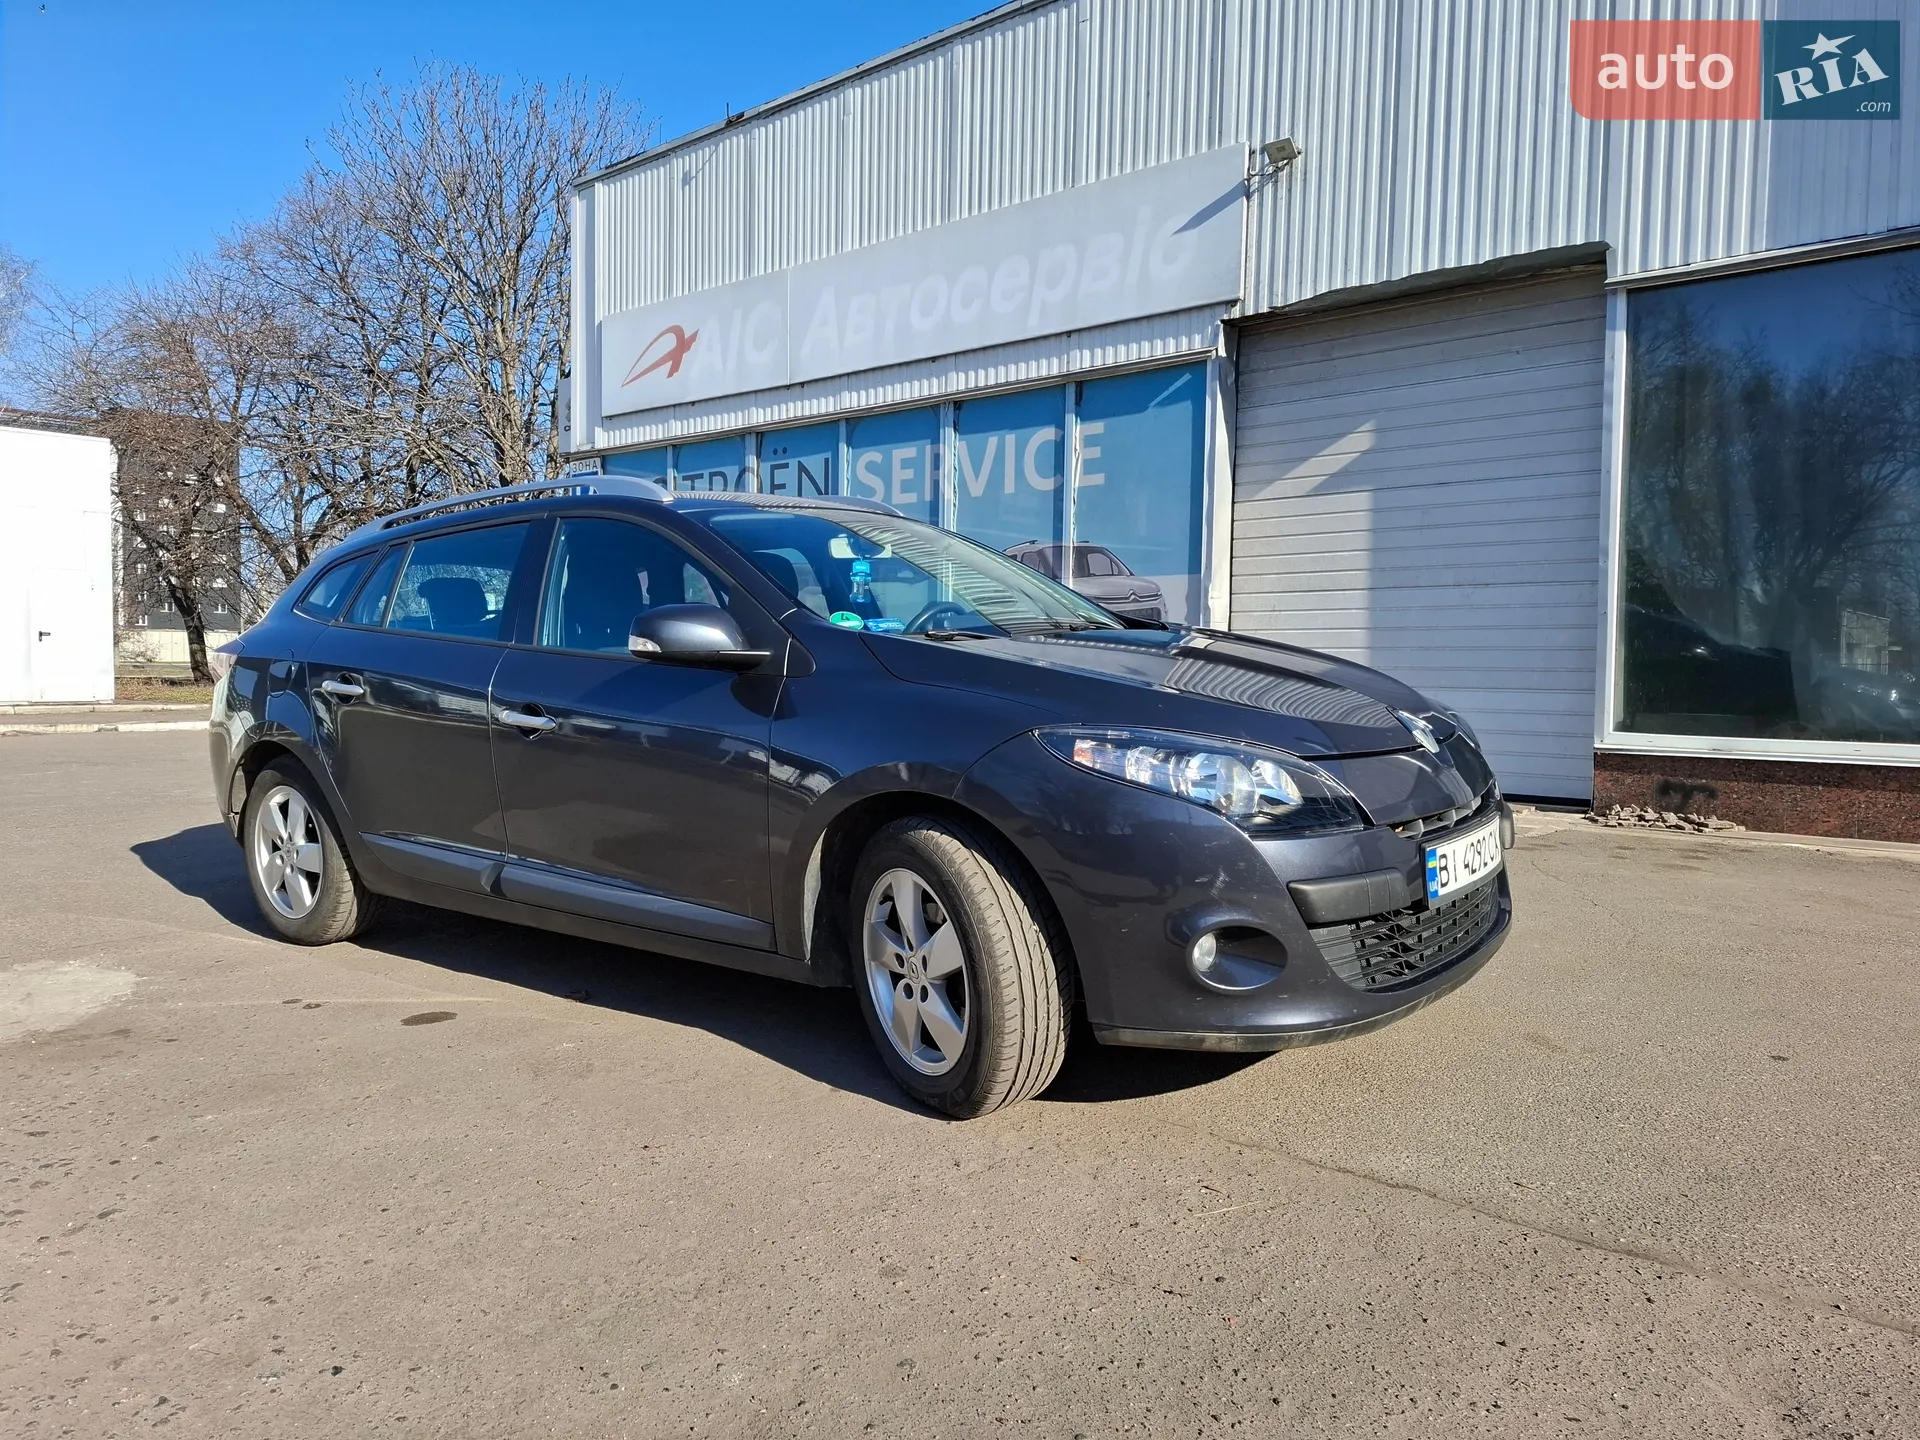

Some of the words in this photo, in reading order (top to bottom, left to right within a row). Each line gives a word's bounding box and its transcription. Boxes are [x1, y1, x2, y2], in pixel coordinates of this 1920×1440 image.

[572, 459, 598, 473] ЗОНА
[856, 421, 1105, 505] SERVICE
[1463, 834, 1488, 876] 4292
